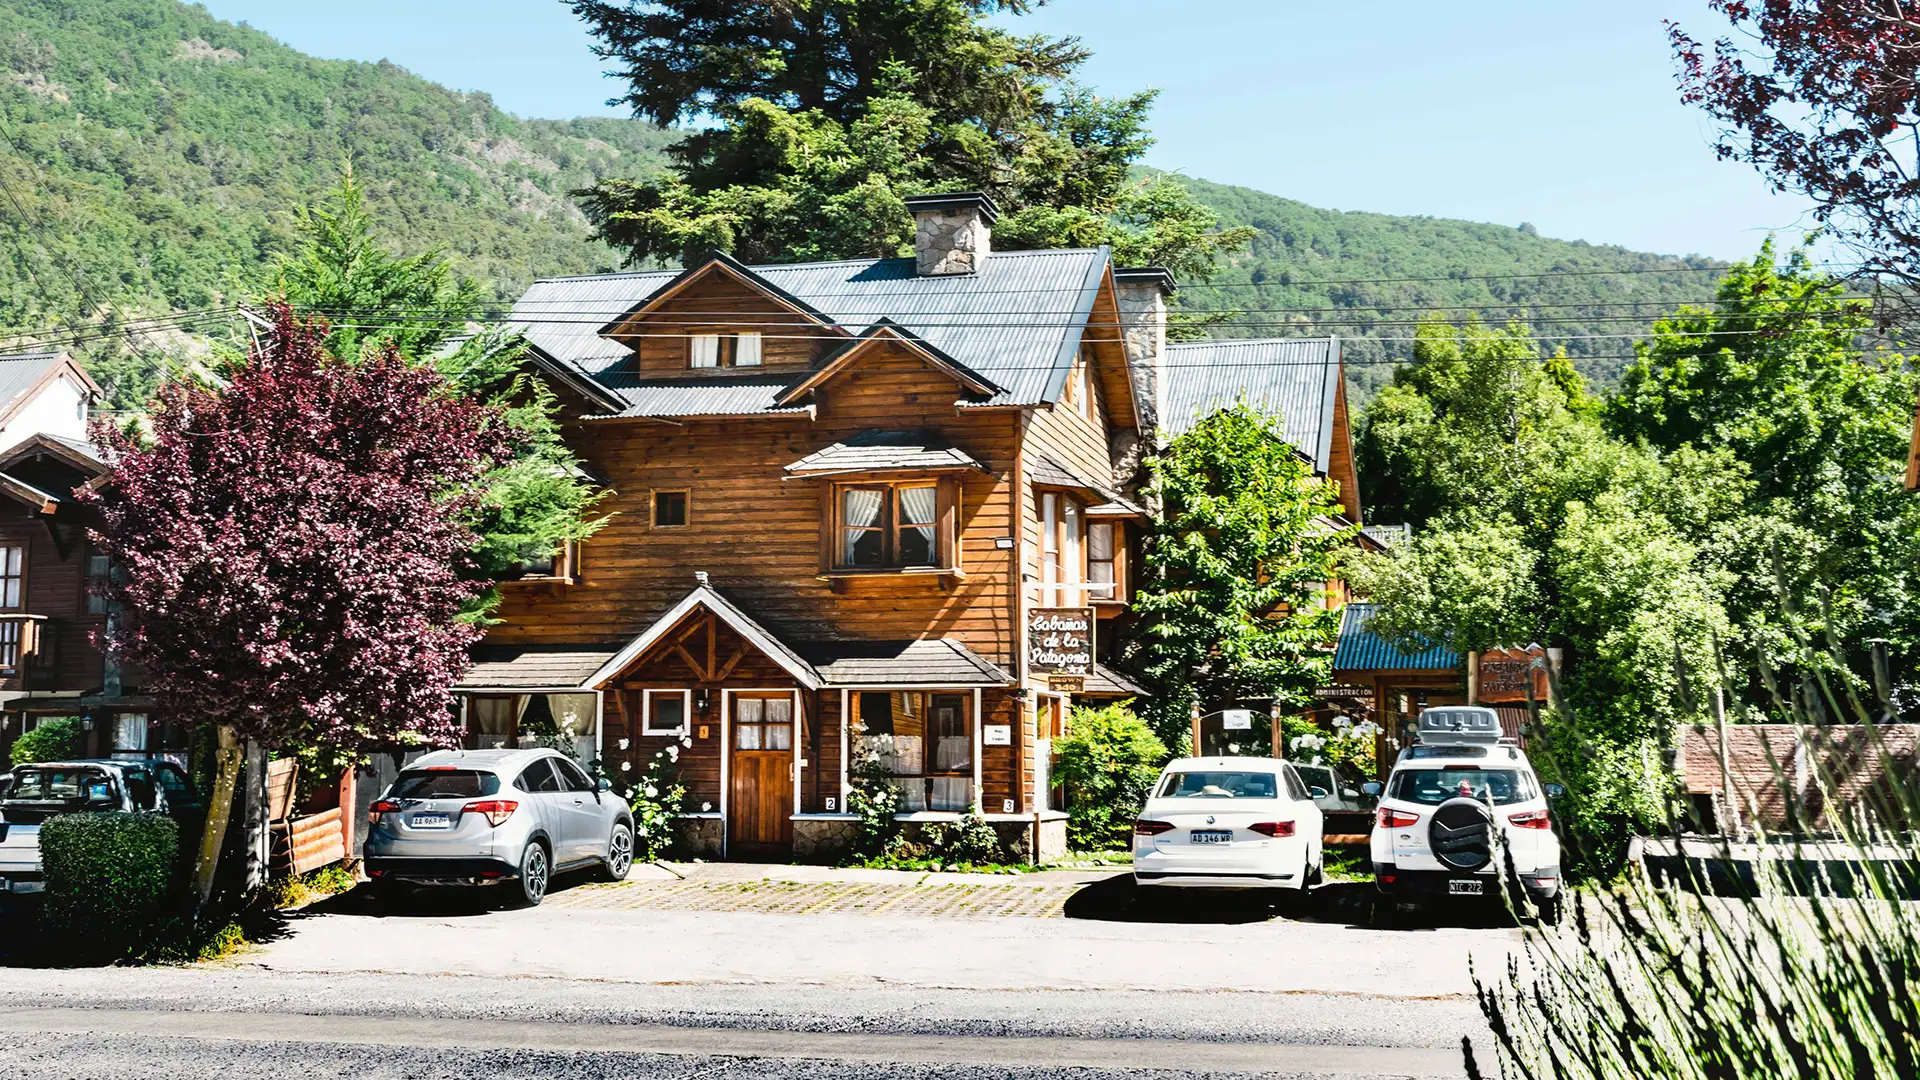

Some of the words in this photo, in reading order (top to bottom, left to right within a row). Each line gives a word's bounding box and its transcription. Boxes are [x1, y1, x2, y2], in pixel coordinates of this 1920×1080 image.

[1030, 615, 1088, 631] Cabañas
[1043, 632, 1060, 647] de
[1063, 632, 1079, 648] la
[1030, 647, 1090, 667] Patagonia
[827, 799, 834, 809] 2
[1005, 800, 1012, 811] 3
[1192, 835, 1203, 843] AD
[1204, 835, 1219, 843] 146
